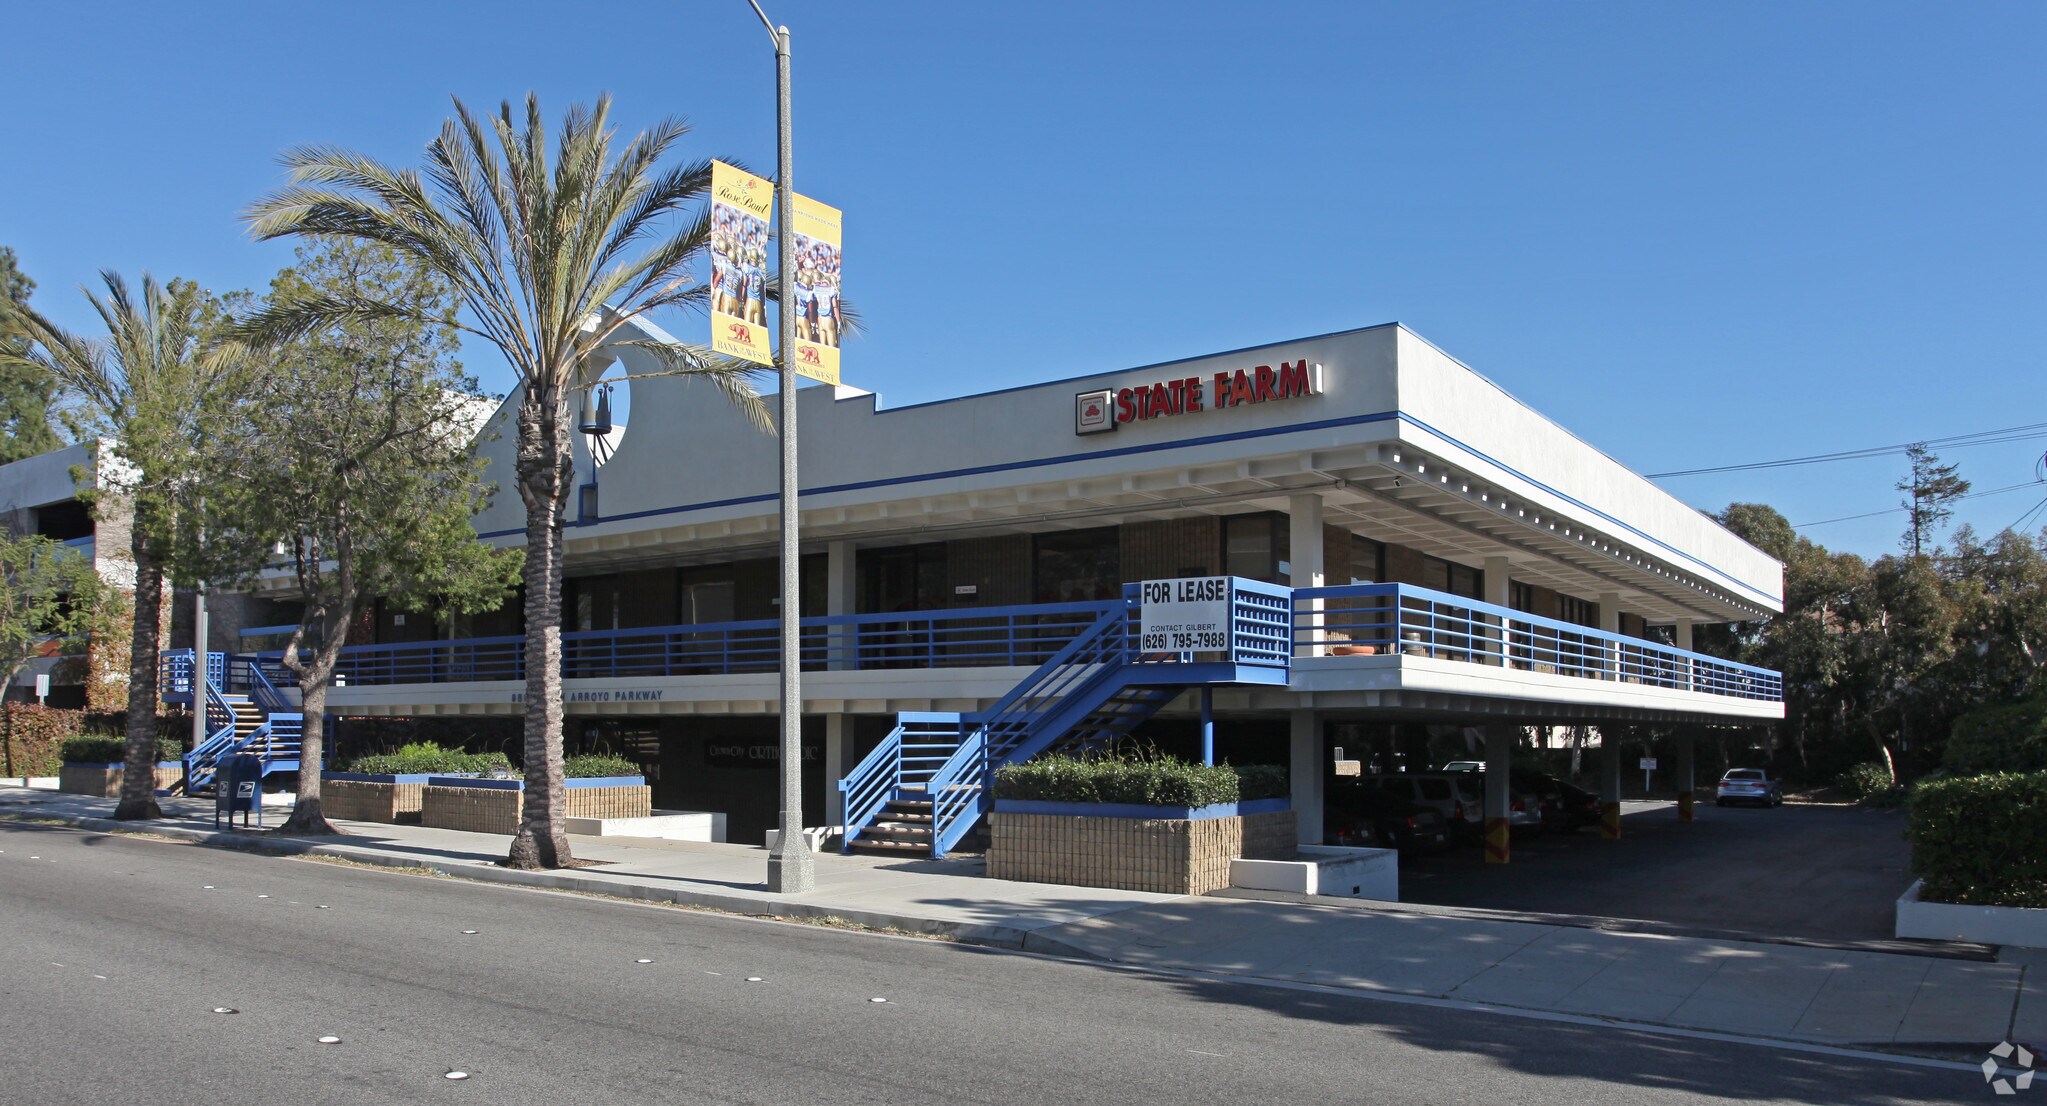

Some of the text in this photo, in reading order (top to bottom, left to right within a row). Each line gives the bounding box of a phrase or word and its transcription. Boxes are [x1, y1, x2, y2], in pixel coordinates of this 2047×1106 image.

[715, 185, 769, 214] Rose Bowl
[748, 274, 762, 291] 12
[717, 339, 739, 354] BANK
[745, 347, 768, 361] WEST
[814, 369, 835, 382] WEST
[1117, 359, 1312, 424] STATE FARM
[1144, 580, 1225, 604] FOR LEASE
[1150, 623, 1217, 632] CONTACT GILBERT
[1142, 632, 1225, 650] (626) 795-7988
[570, 691, 610, 702] ARROYO
[615, 690, 664, 701] PARKWAY
